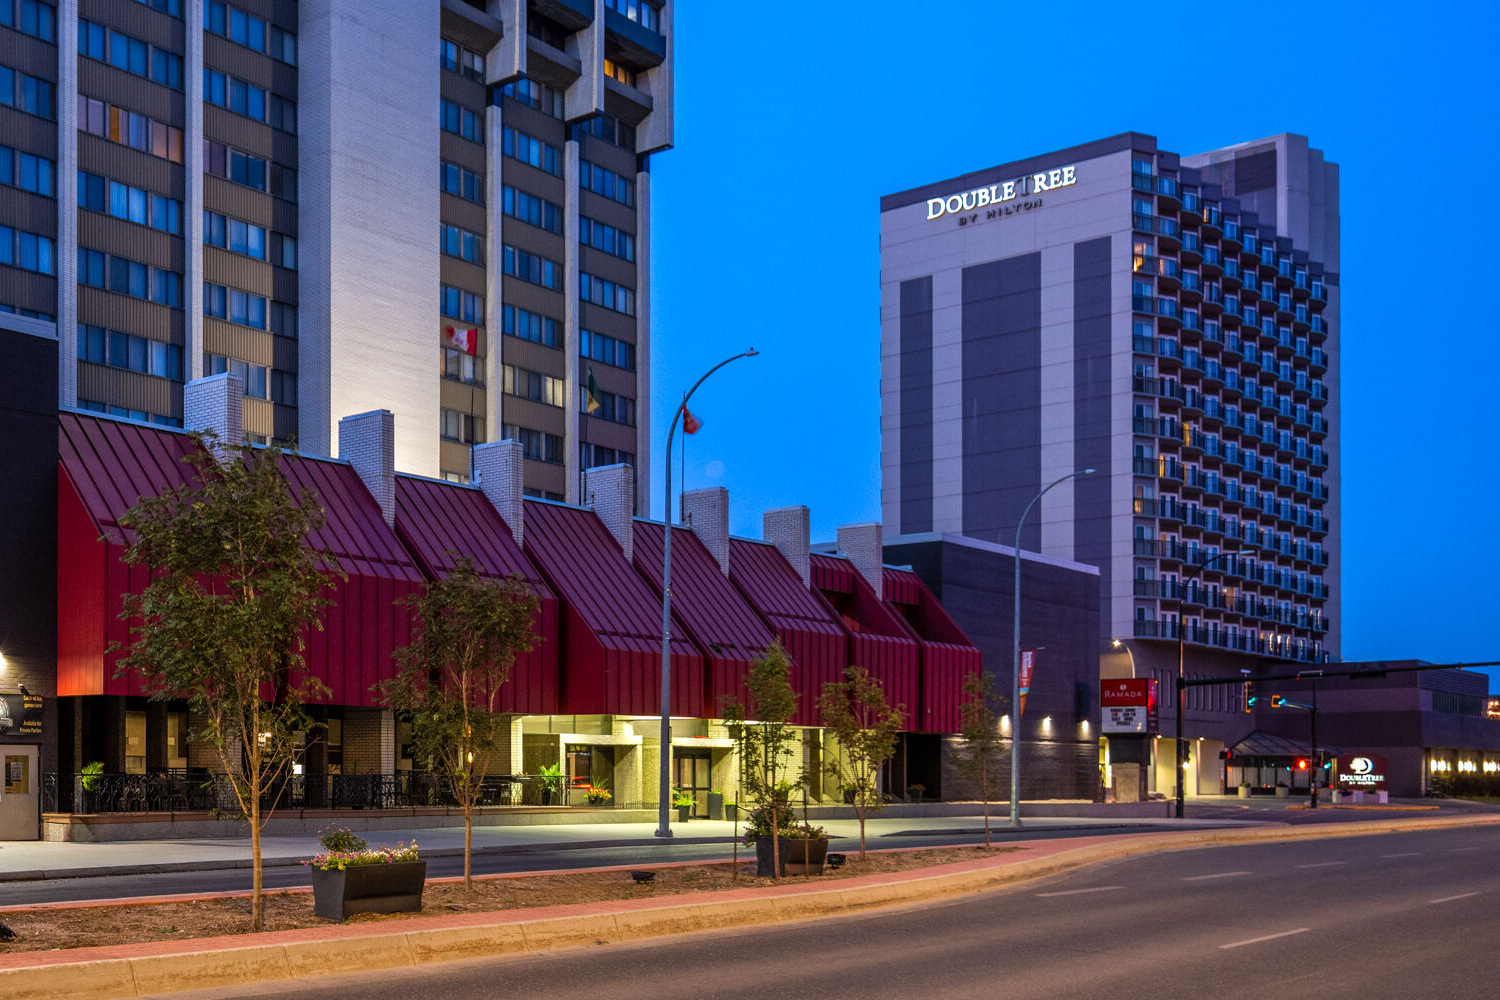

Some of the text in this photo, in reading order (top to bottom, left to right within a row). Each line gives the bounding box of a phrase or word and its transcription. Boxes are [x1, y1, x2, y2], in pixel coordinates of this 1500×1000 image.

[927, 165, 1077, 220] DOUBLETREE
[958, 199, 1042, 226] BY HILTON
[1104, 690, 1142, 698] RAMADA
